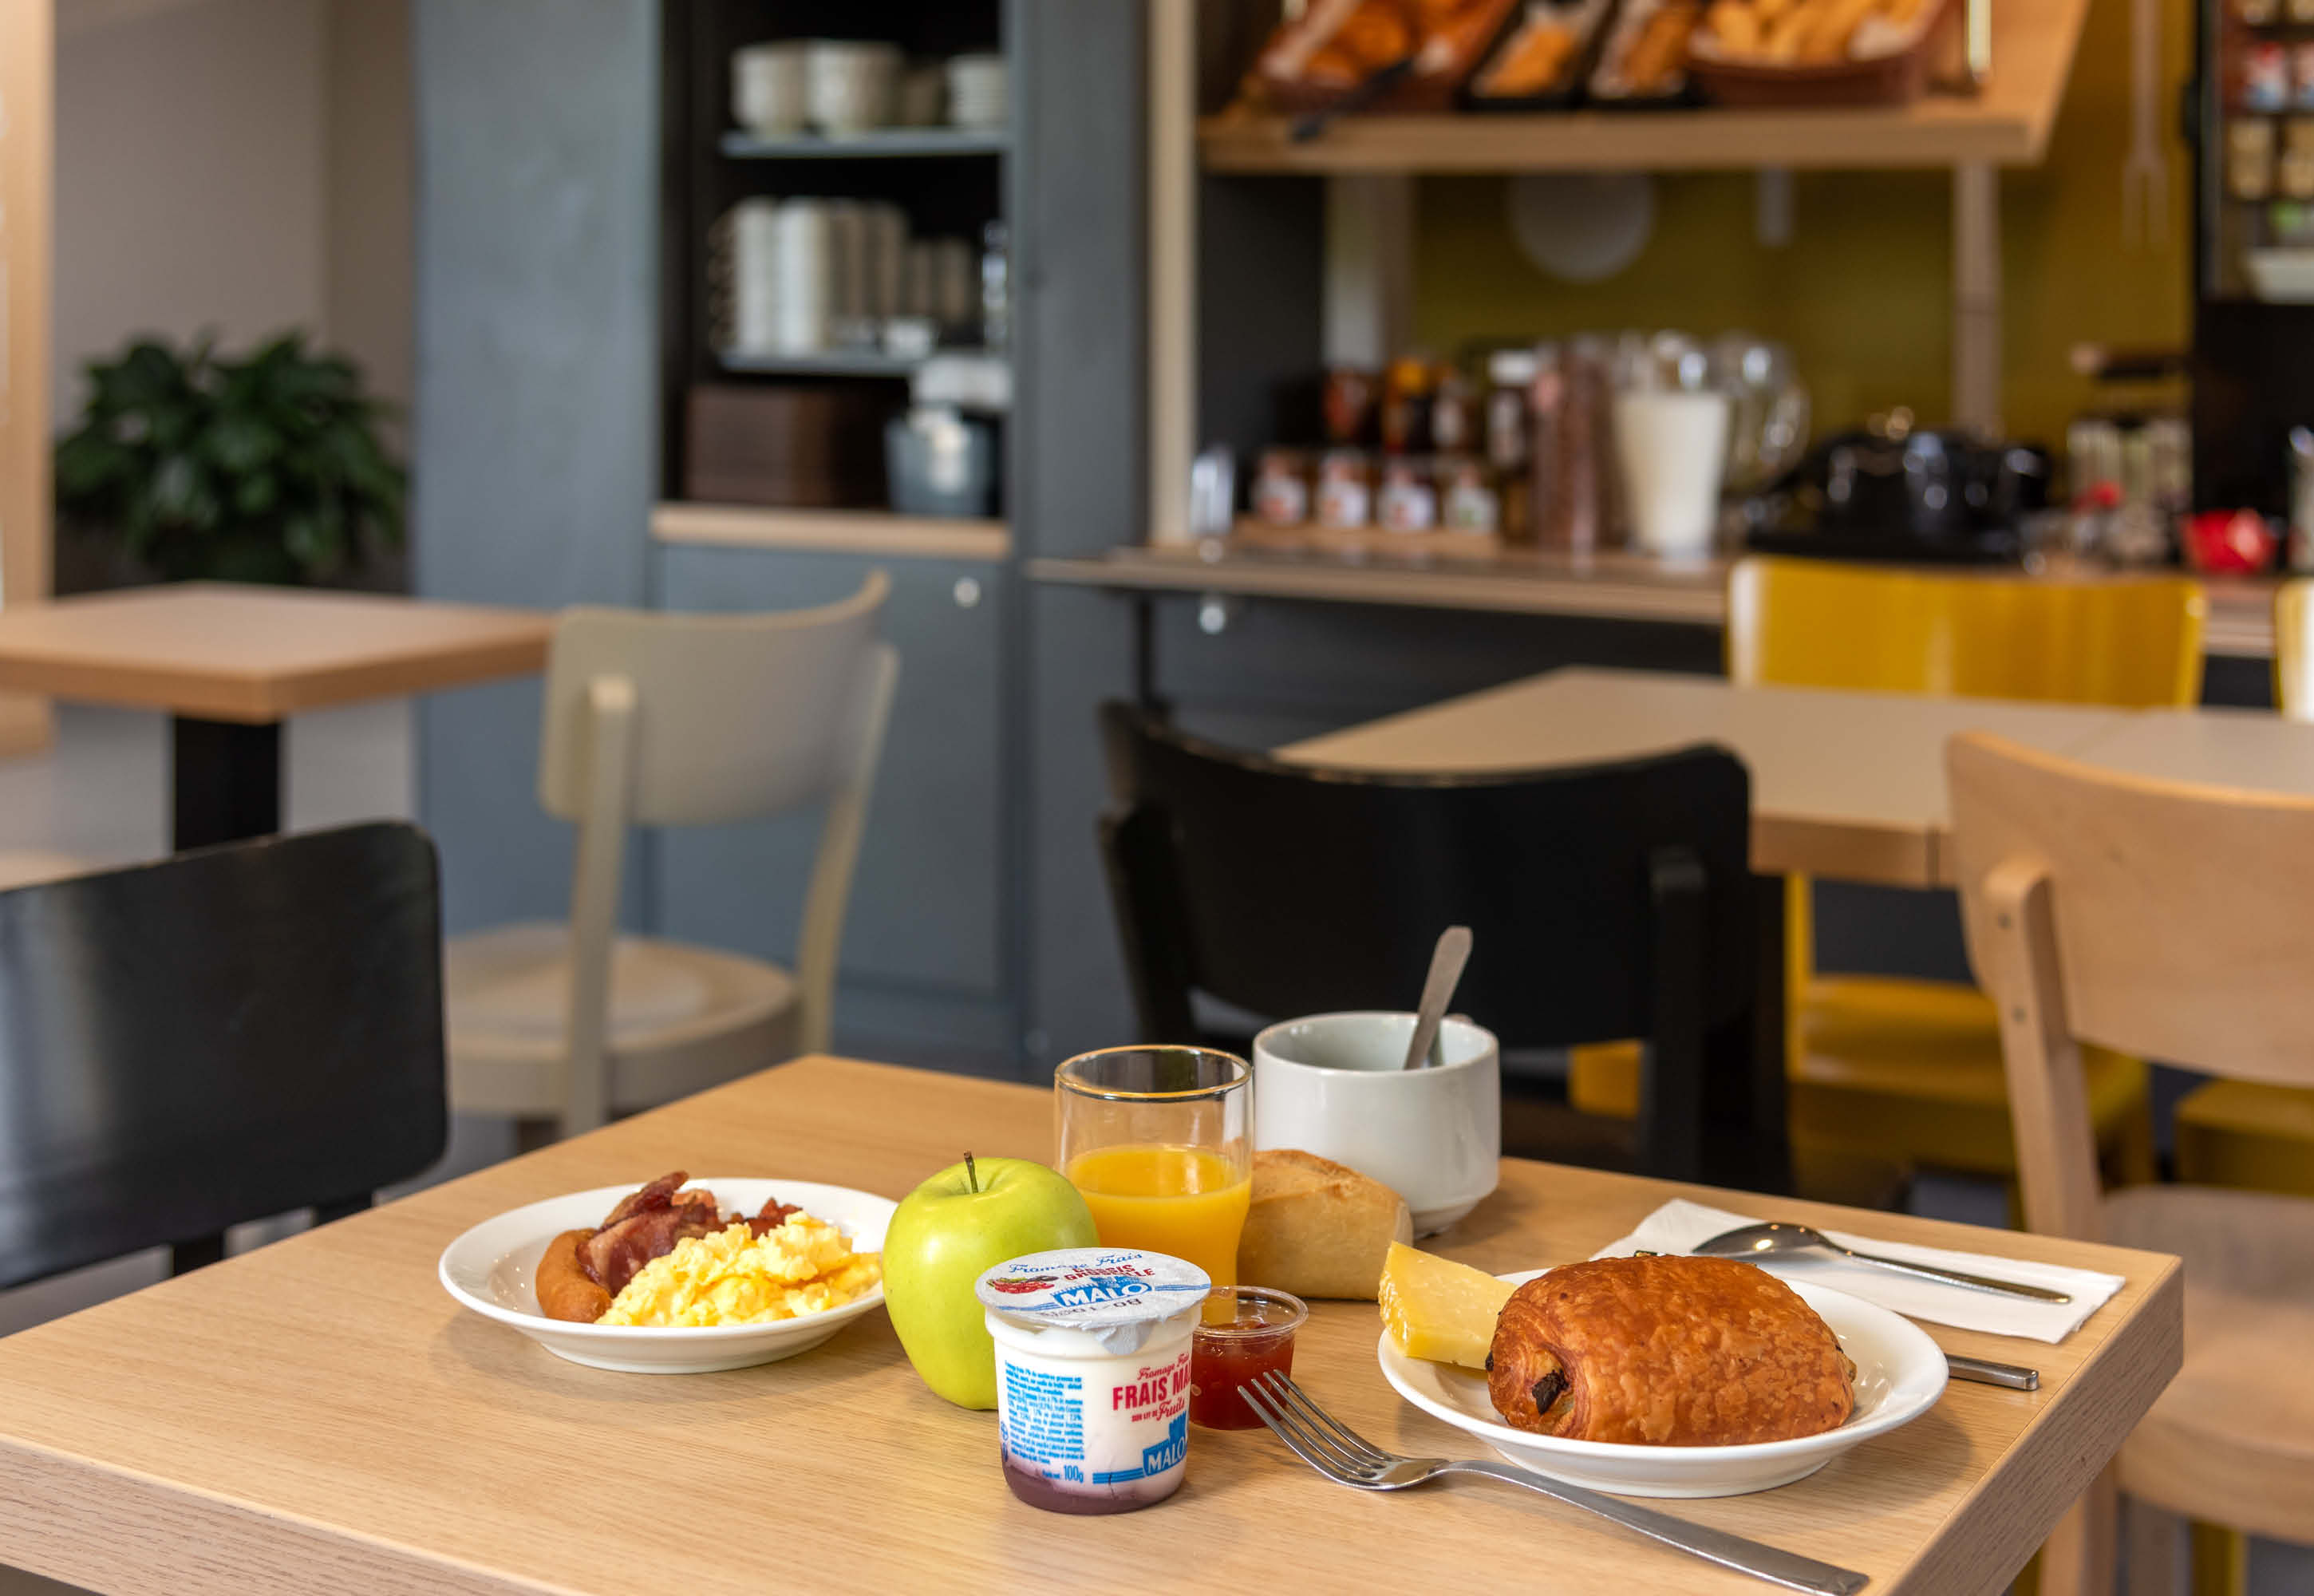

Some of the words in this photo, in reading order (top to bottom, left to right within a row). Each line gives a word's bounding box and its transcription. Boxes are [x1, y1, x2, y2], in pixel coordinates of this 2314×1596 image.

[1096, 1252, 1143, 1266] Frais
[1060, 1282, 1148, 1306] MALO
[1137, 1364, 1175, 1381] Fromage
[1112, 1377, 1167, 1411] FRAIS
[1156, 1396, 1185, 1421] Fruits
[1148, 1436, 1185, 1474] MALO
[1064, 1465, 1084, 1483] 100g
